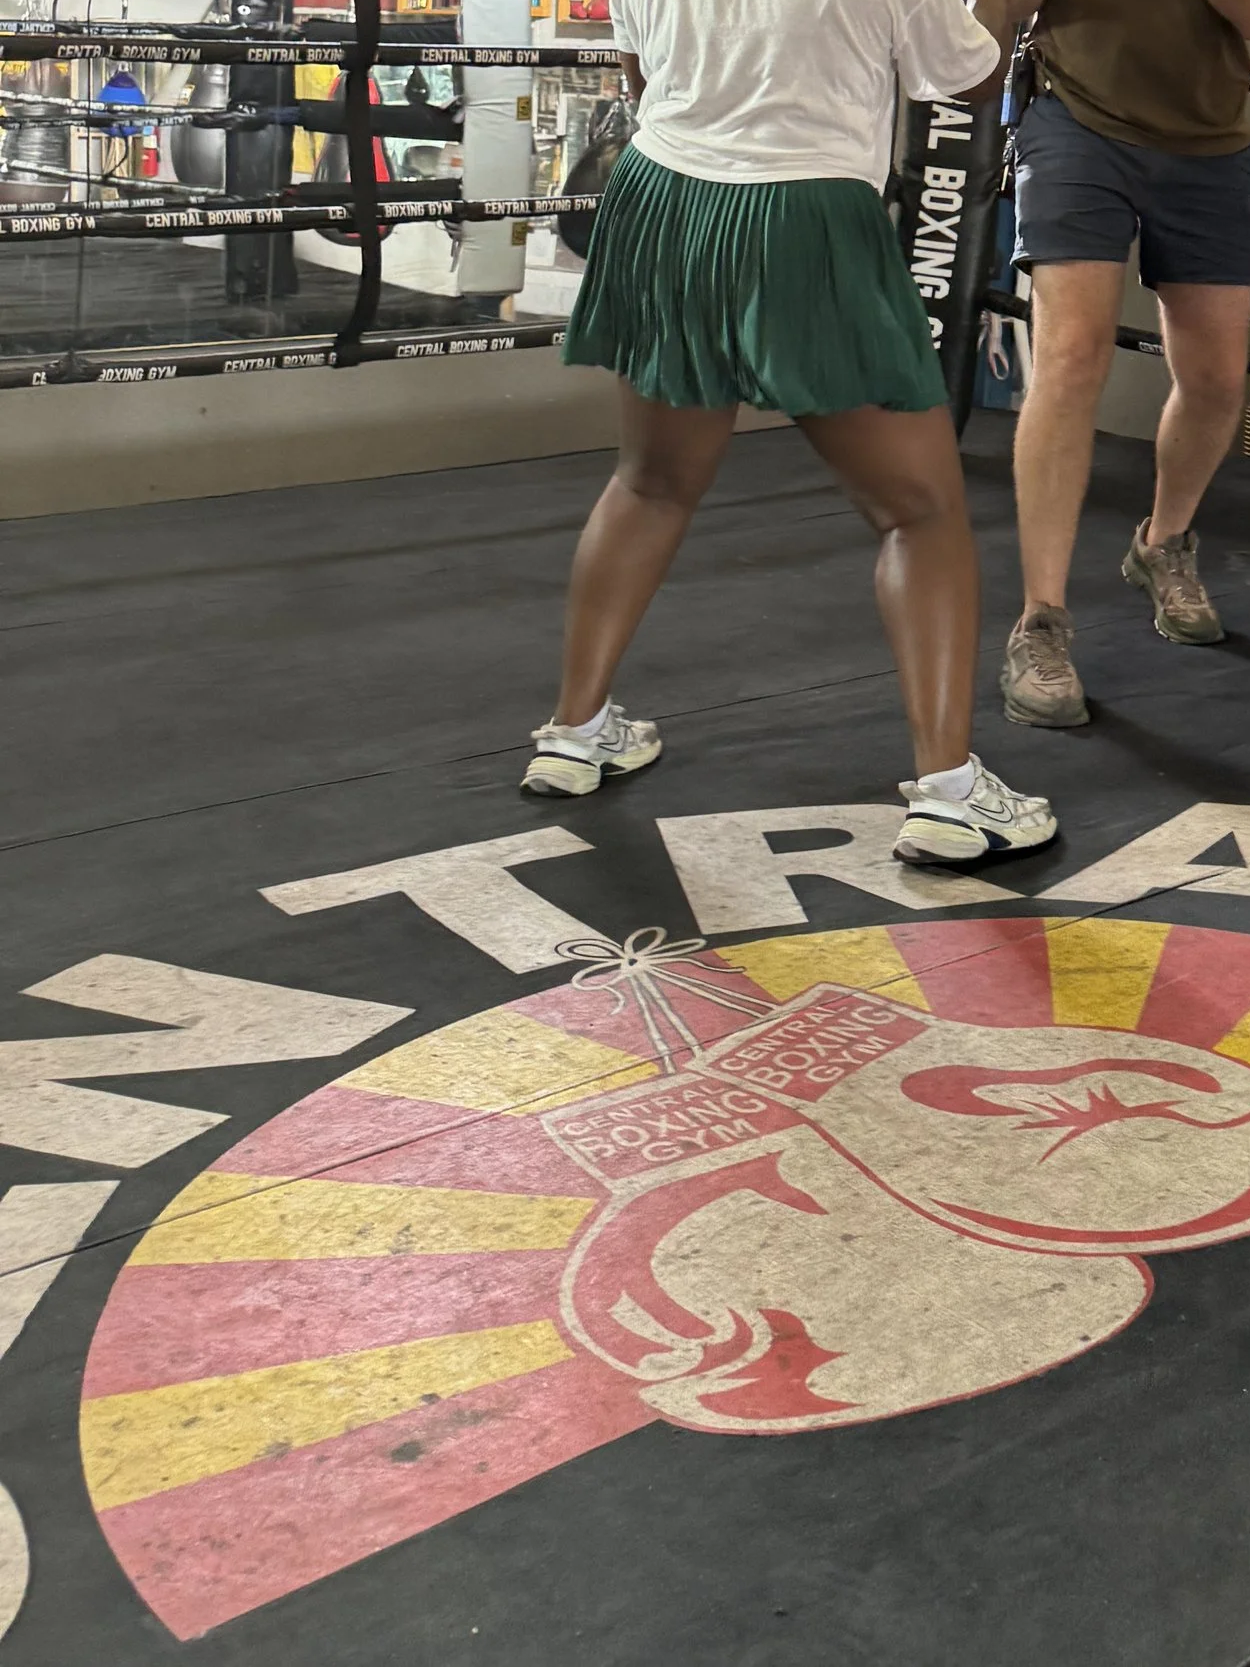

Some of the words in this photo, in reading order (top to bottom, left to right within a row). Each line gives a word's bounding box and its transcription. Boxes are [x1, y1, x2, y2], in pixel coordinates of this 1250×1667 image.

[57, 45, 117, 58] CENTRL
[122, 45, 168, 61] BOXING
[172, 48, 201, 62] GYM
[247, 48, 301, 63] CENTRAL
[422, 49, 470, 63] CENTRAL
[474, 49, 513, 64] BOXING
[516, 50, 540, 64] GYM
[578, 50, 621, 64] CENTRAL
[384, 203, 425, 217] BOXING
[429, 201, 452, 216] GYM
[484, 200, 530, 214] CENTRAL
[535, 199, 571, 213] BOXING
[574, 197, 596, 211] GYM
[12, 218, 61, 232] BOXING
[146, 210, 204, 227] CENTRAL
[209, 210, 252, 225] BOXING
[256, 209, 283, 223] GYM
[910, 165, 967, 301] BOXING
[397, 343, 446, 358] CENTRAL
[450, 339, 488, 354] BOXING
[491, 337, 514, 351] GYM
[223, 357, 277, 373] CENTRAL
[282, 352, 325, 368] BOXING
[148, 365, 177, 380] GYM
[721, 1005, 847, 1072] CENTRAL
[744, 1005, 897, 1089] BOXING
[806, 1035, 893, 1084] GYM
[563, 1084, 735, 1136] CENTRAL
[573, 1090, 768, 1162] BOXING
[641, 1118, 760, 1162] GYM
